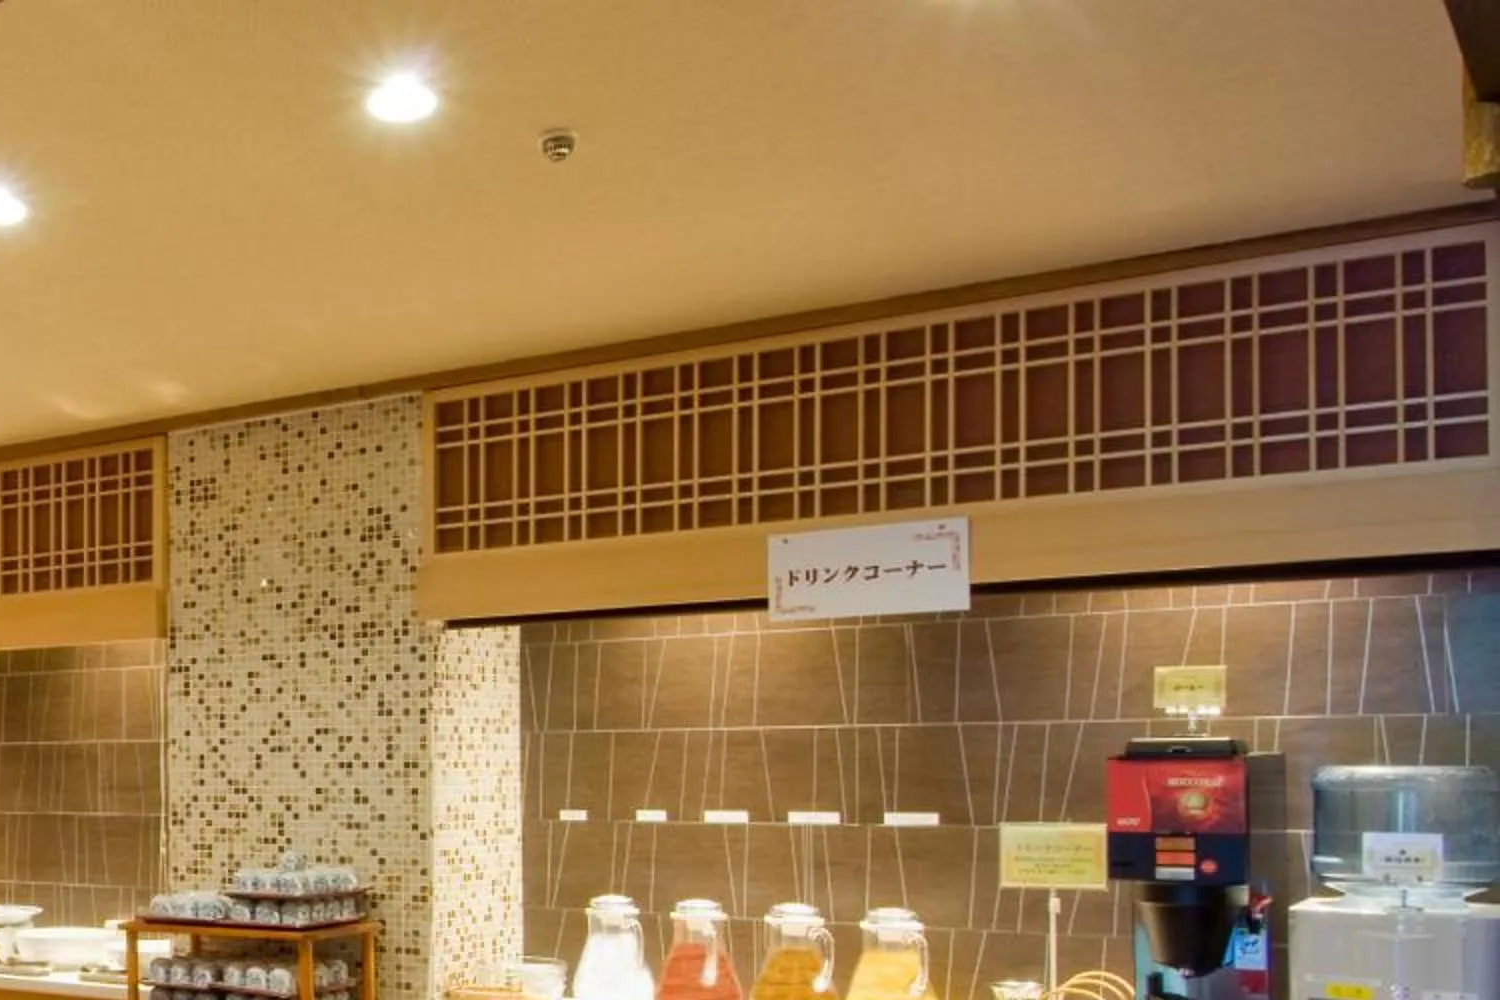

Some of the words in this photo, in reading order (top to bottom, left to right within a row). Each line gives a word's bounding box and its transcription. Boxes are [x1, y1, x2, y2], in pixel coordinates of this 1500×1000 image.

[788, 560, 947, 587] ドリンクコーナー
